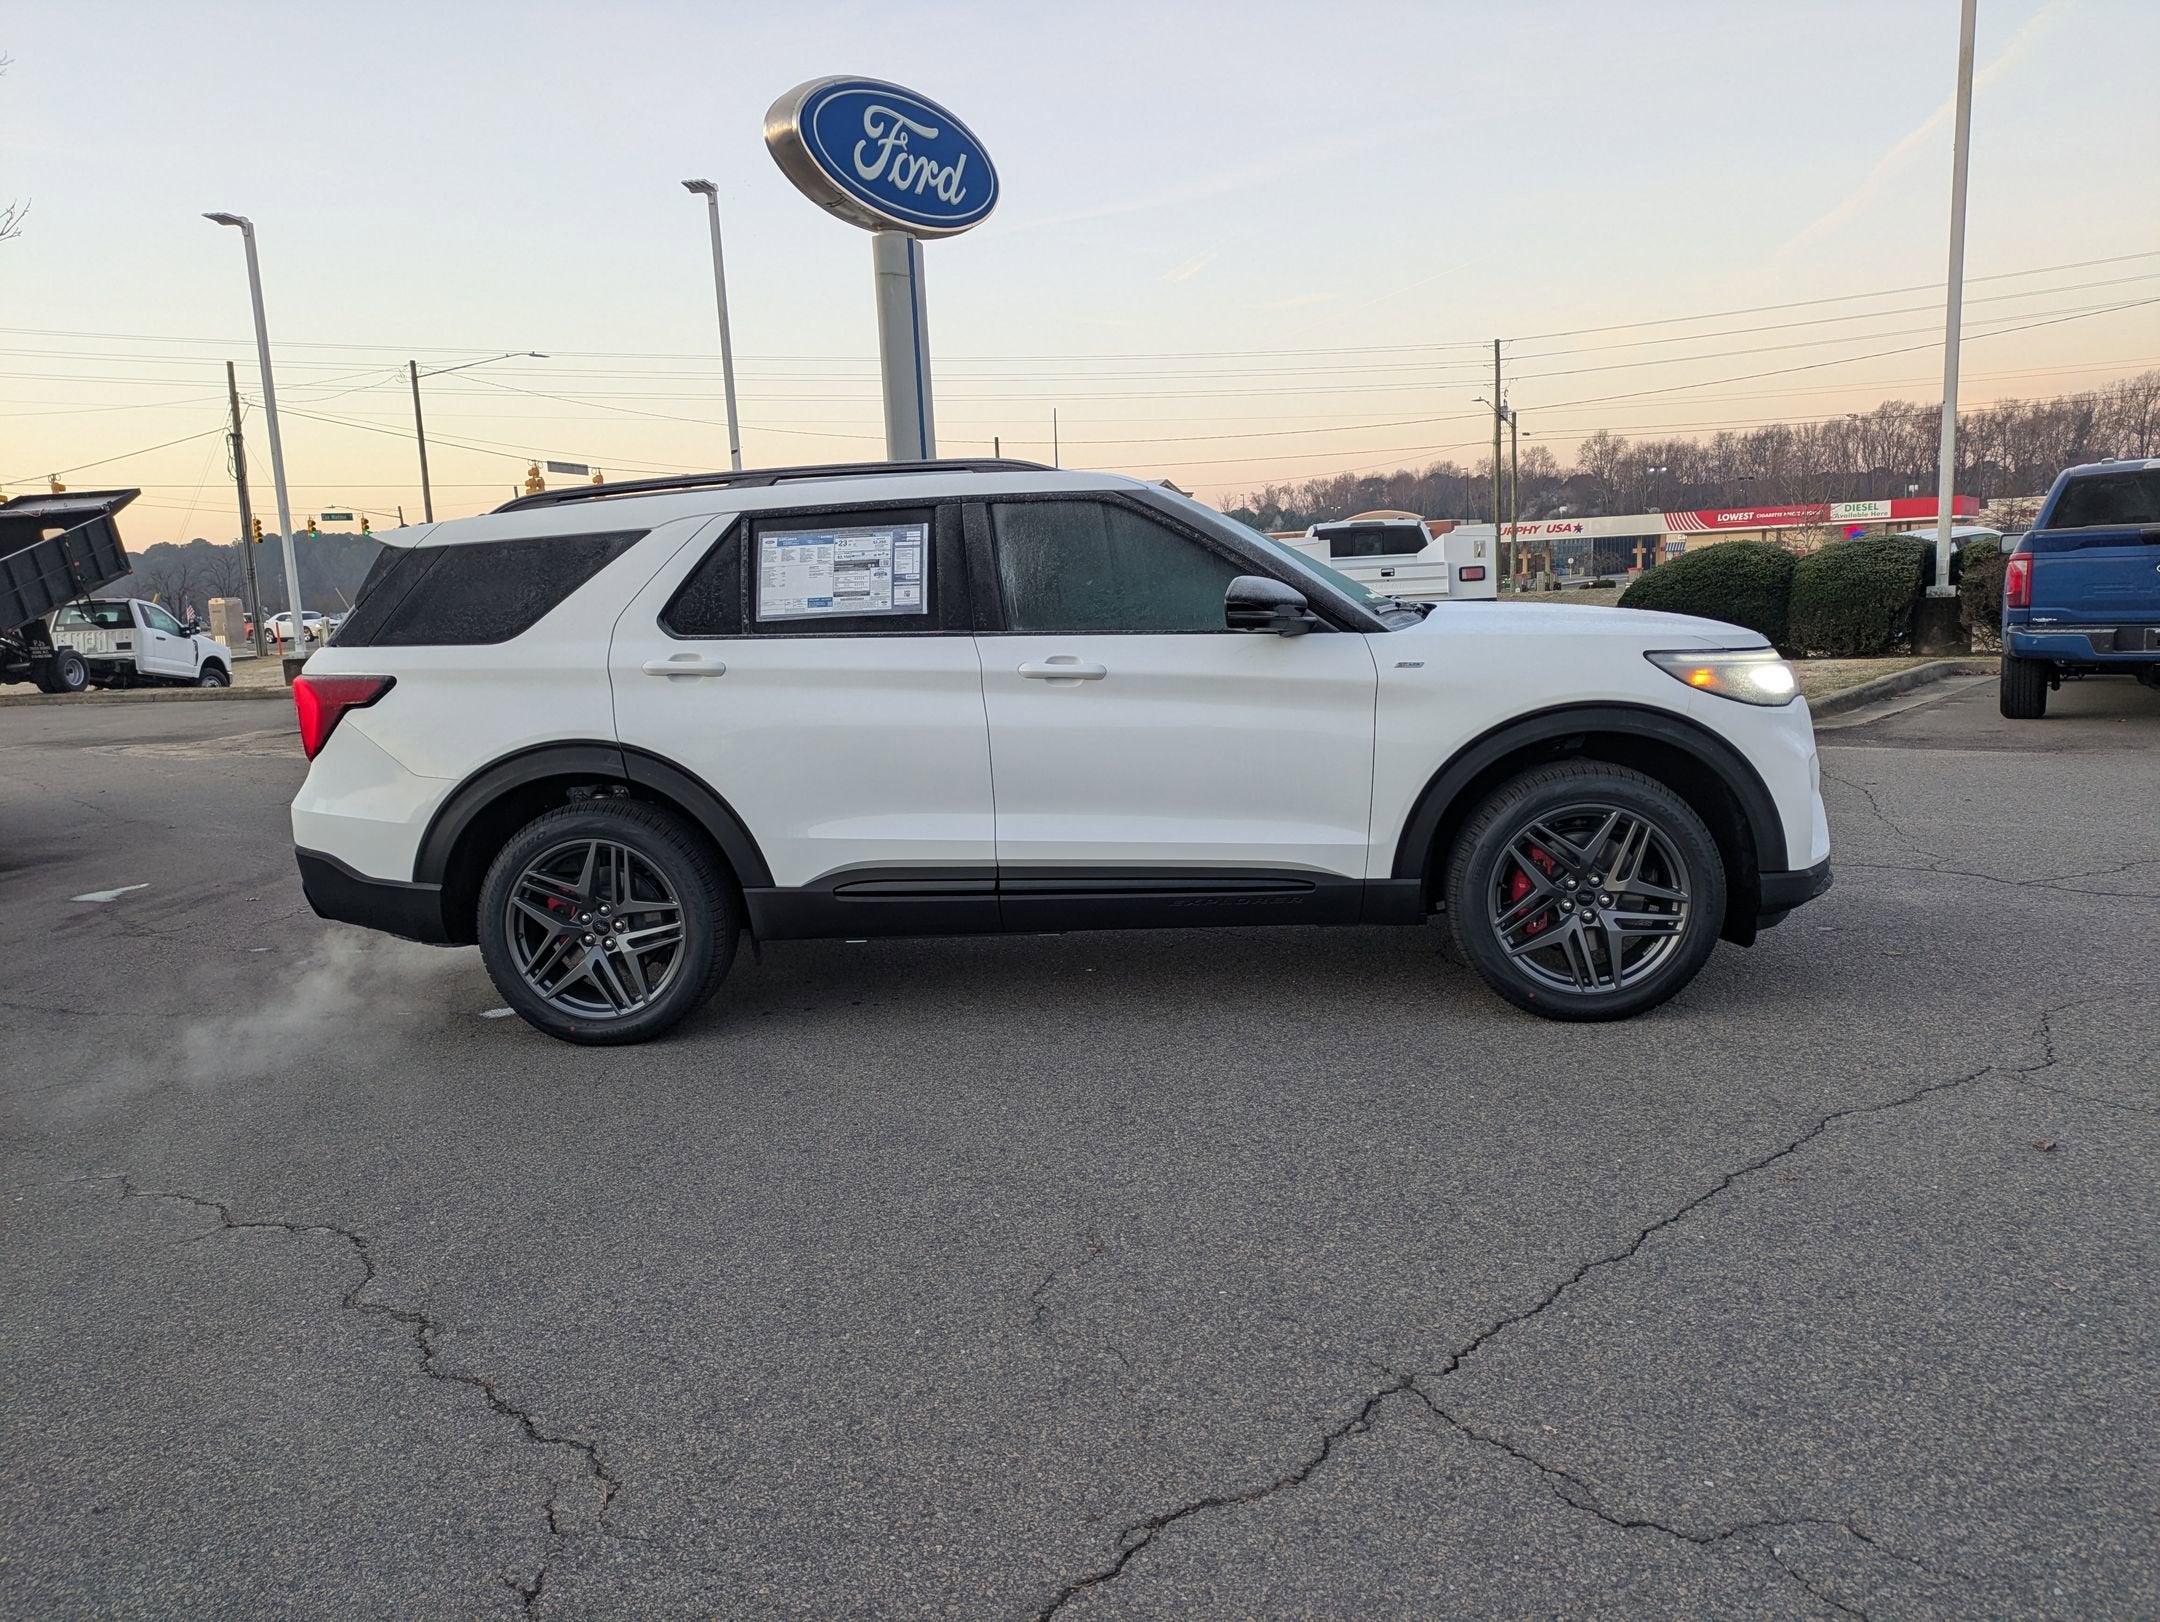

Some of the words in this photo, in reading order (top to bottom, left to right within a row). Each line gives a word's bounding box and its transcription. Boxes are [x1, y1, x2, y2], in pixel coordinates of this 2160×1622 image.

[853, 104, 967, 205] Ford
[1844, 502, 1879, 512] DIESEL
[1717, 511, 1754, 522] LOWEST
[1546, 523, 1572, 534] USA
[1167, 896, 1304, 907] EXPLORER
